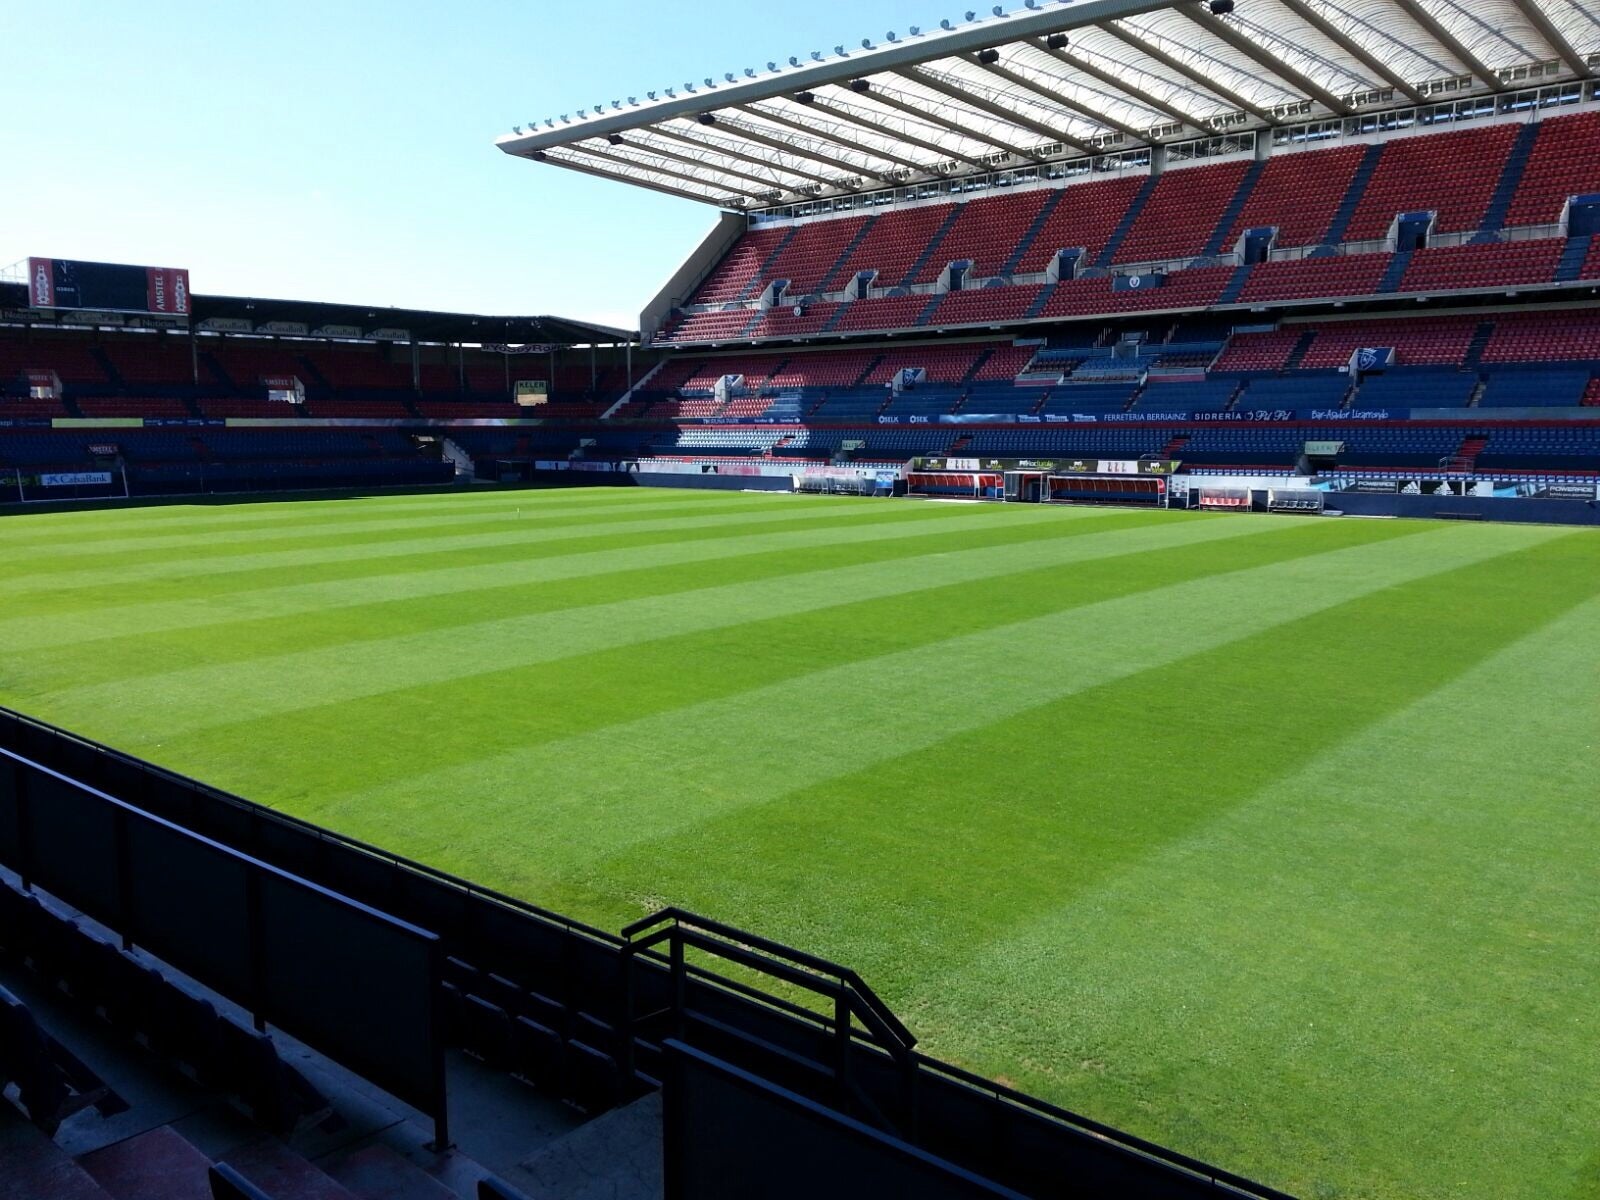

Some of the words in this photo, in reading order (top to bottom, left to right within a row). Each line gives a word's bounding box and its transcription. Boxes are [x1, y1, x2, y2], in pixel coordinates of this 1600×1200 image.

[155, 275, 164, 311] AMSTEL
[1146, 412, 1187, 421] BERRIAINZ
[1194, 411, 1242, 421] SIDRERÍA
[1352, 409, 1389, 420] Lizarrondo
[60, 474, 107, 484] CaixaBank
